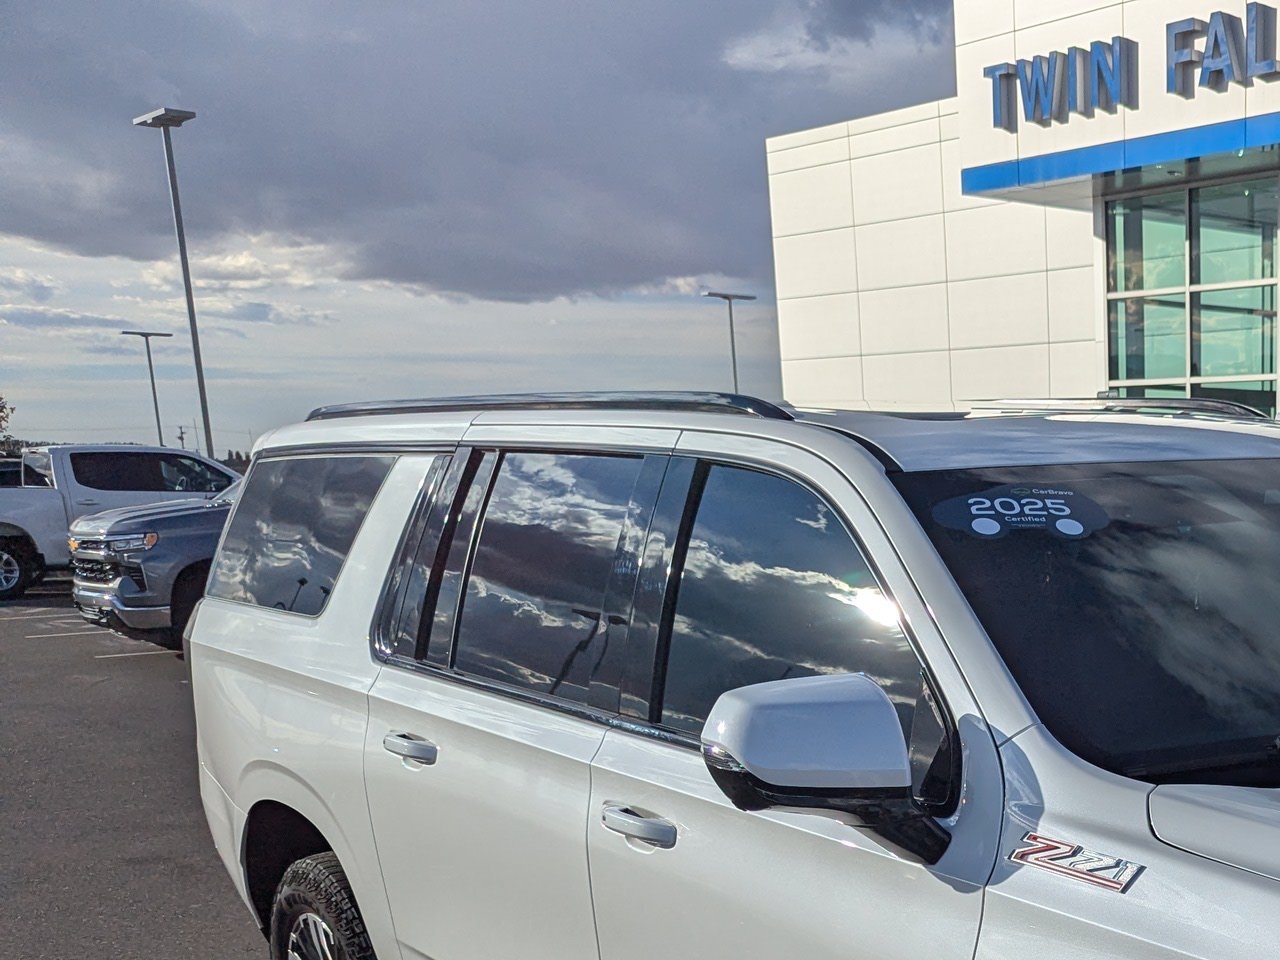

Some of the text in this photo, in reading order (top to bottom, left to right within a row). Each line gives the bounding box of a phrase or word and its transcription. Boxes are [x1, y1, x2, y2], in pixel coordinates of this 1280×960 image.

[983, 36, 1138, 132] TWIN
[967, 497, 1072, 516] 2025
[1007, 831, 1147, 894] Z71
